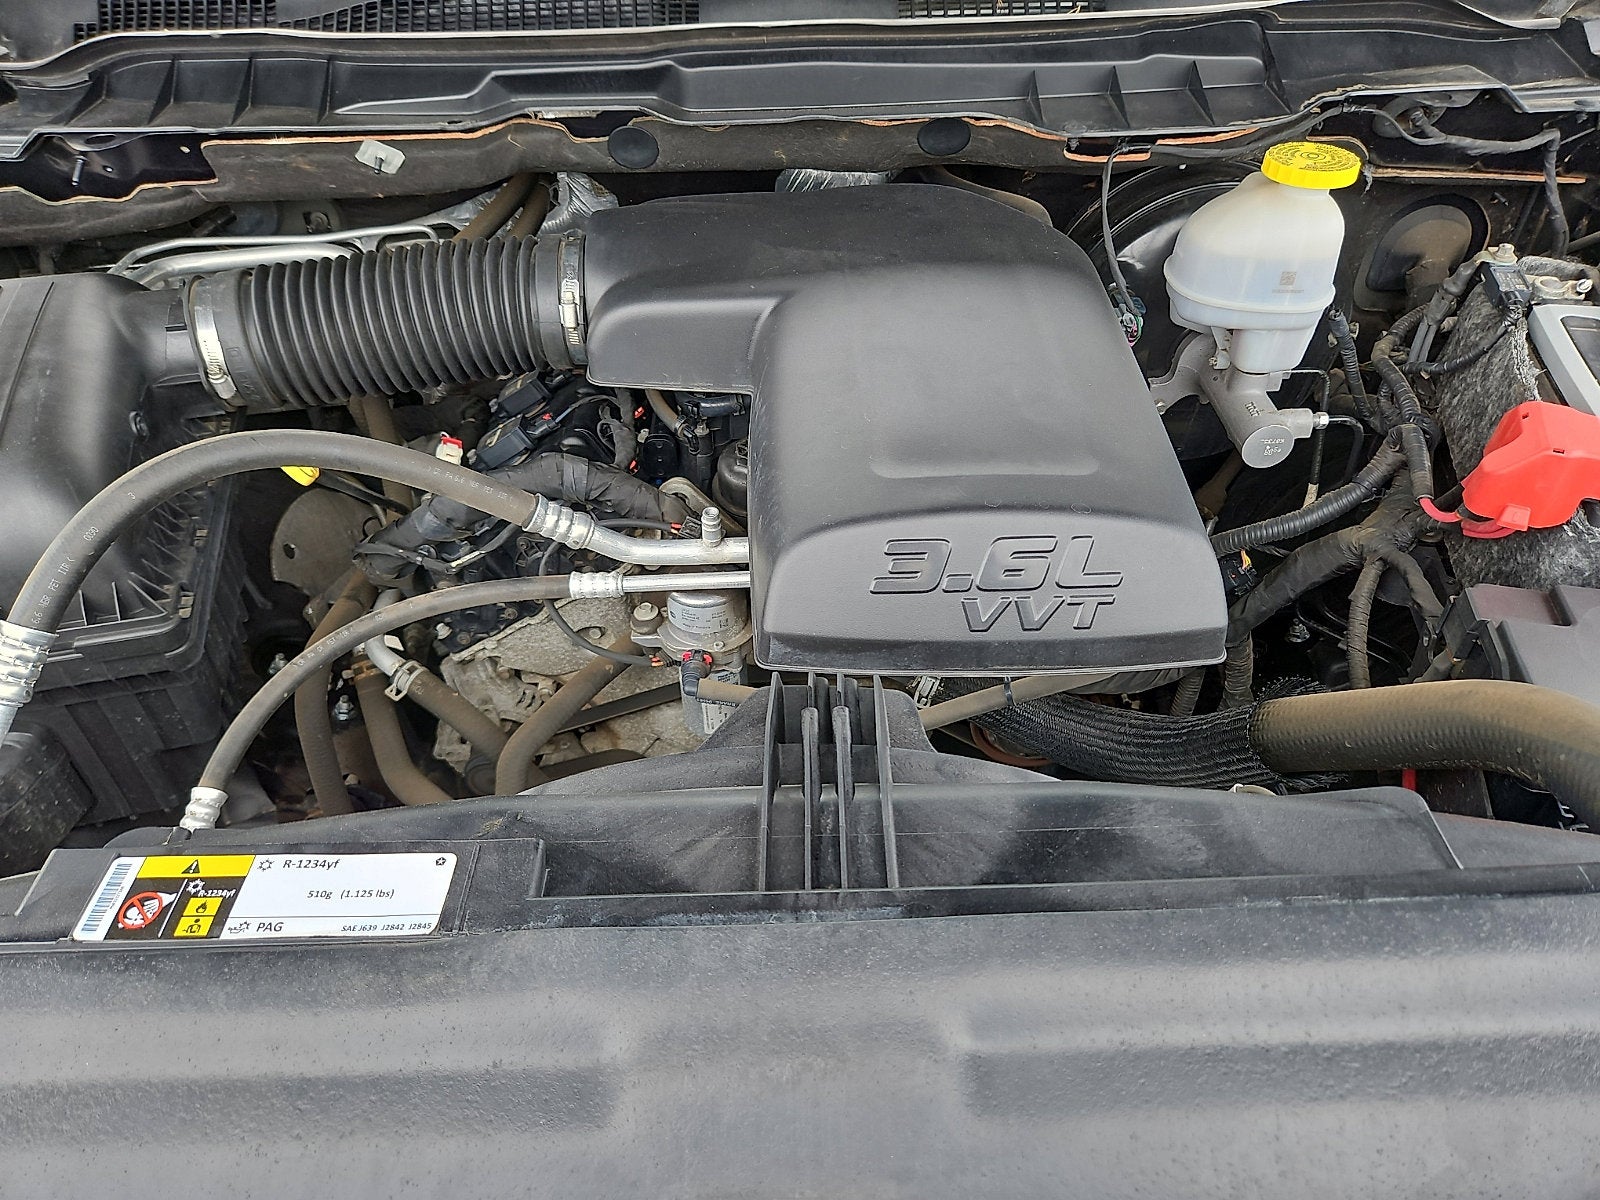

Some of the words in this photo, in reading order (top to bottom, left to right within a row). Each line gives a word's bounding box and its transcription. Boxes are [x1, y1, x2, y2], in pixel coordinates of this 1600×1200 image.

[869, 535, 1124, 594] 3.6L
[961, 594, 1116, 632] VVT
[282, 858, 341, 871] R-1234yf
[306, 889, 333, 900] 510g
[340, 889, 373, 900] (1.125
[375, 888, 395, 900] lbs)
[256, 921, 284, 932] PAG
[340, 924, 357, 932] SAE
[358, 924, 377, 932] J639
[380, 923, 405, 931] J2842
[408, 922, 432, 930] J2845
